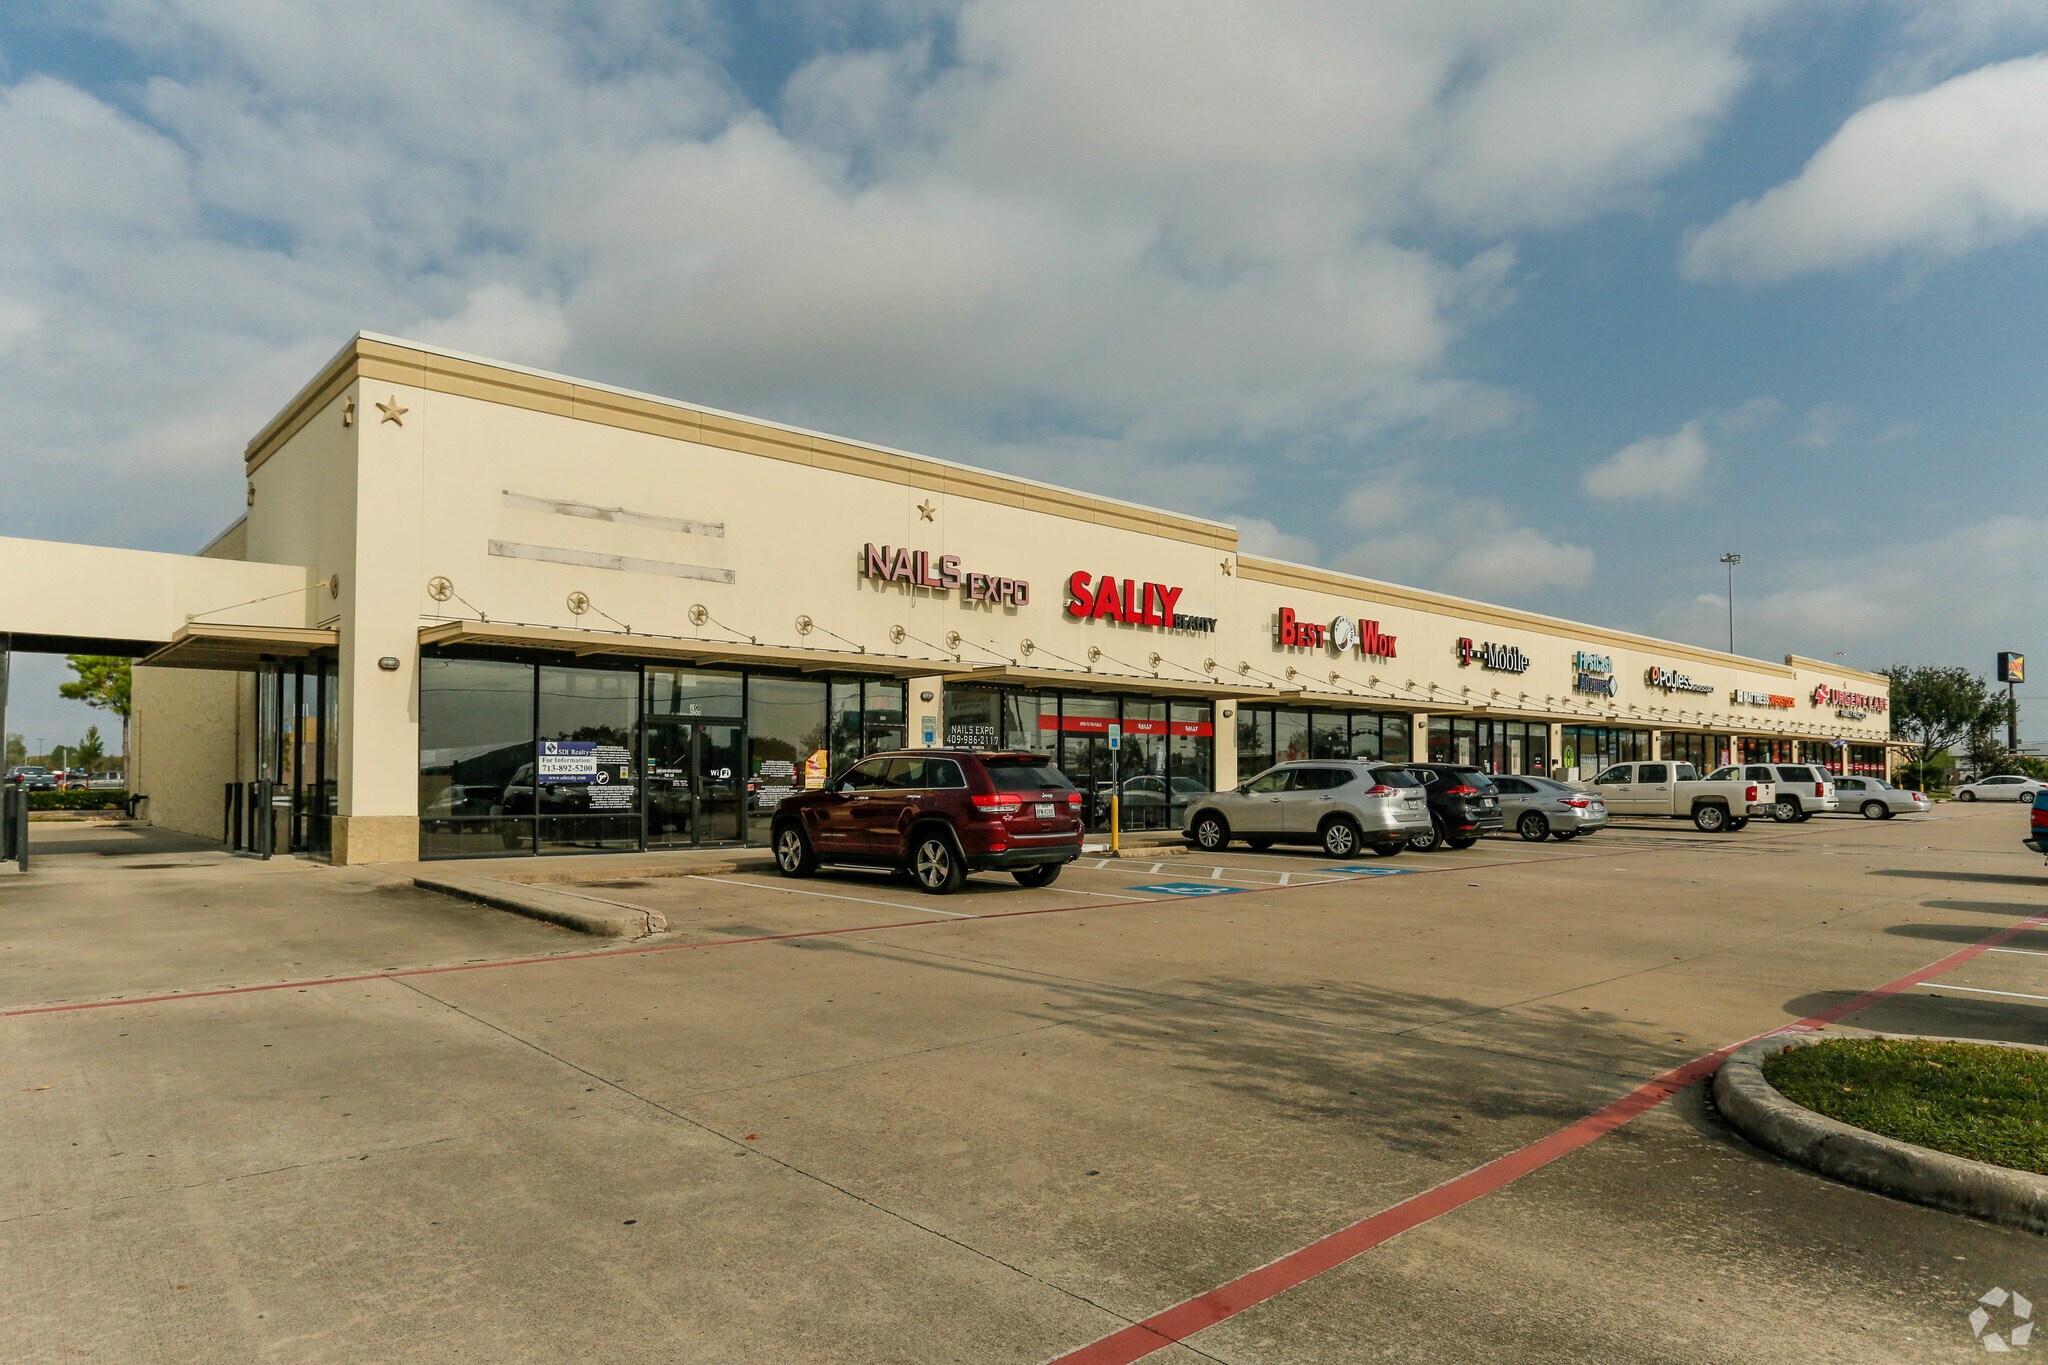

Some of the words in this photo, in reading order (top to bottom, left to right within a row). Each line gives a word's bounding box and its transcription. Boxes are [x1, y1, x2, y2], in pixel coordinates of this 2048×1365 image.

[864, 543, 961, 590] NAILS
[966, 572, 1029, 606] EXPO
[1069, 570, 1183, 628] SALLY
[1173, 613, 1217, 633] BEAUTY
[1278, 607, 1326, 649] BEST
[1358, 618, 1397, 658] WOK
[2009, 661, 2023, 673] SONIC
[1660, 668, 1692, 692] Payless
[1830, 688, 1866, 708] URGENT
[1867, 695, 1888, 711] CARE
[951, 725, 974, 735] NAILS
[975, 726, 994, 735] EXPO
[542, 764, 593, 772] 713-892-5200
